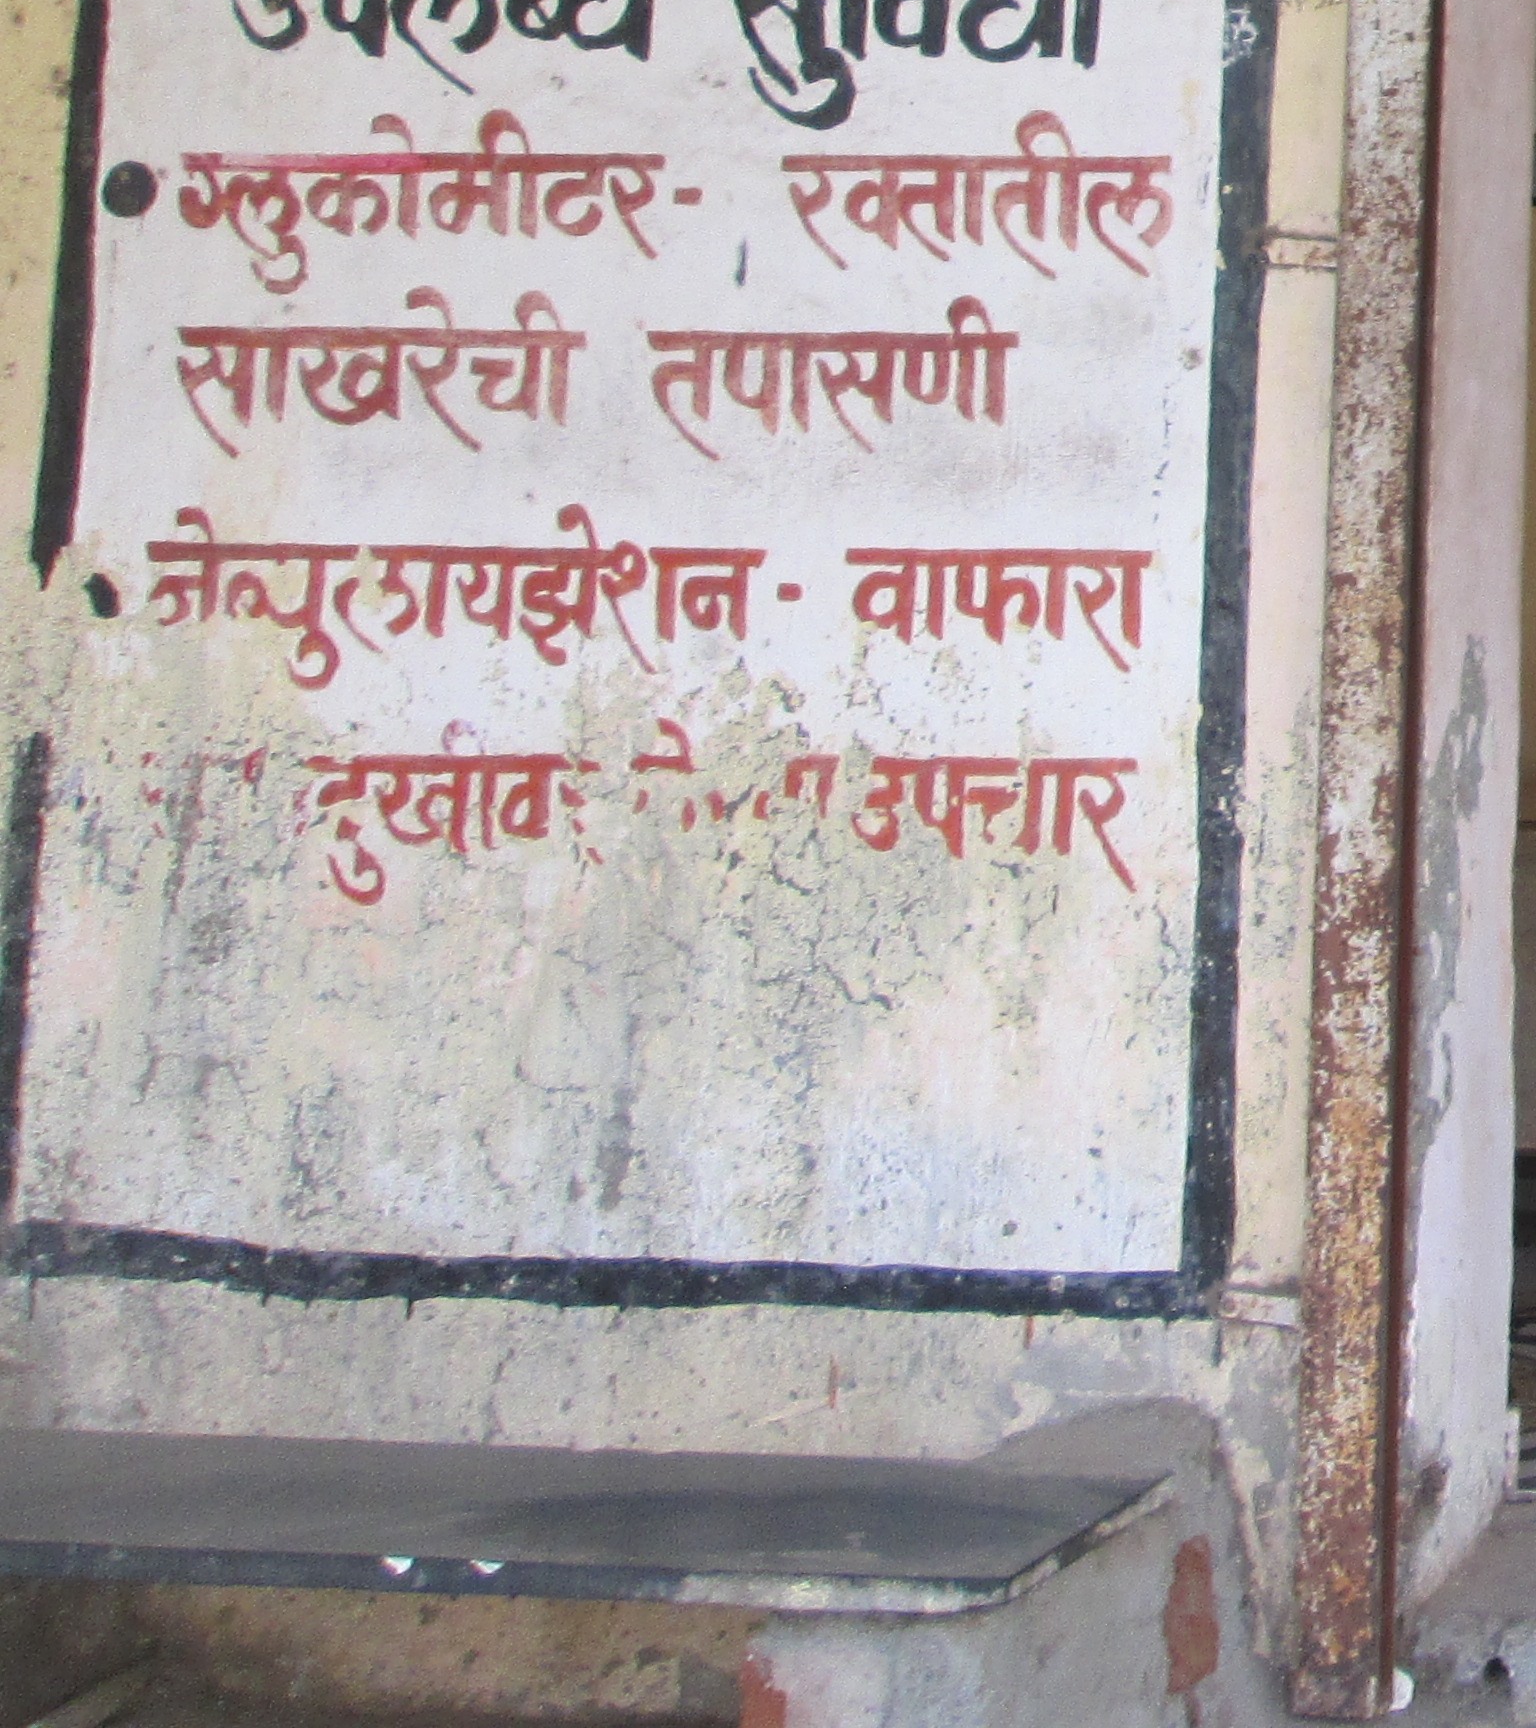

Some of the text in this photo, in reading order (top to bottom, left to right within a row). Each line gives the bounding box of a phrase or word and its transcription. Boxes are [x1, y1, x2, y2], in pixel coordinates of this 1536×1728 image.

[782, 109, 1174, 278] रक्तातील
[176, 284, 1019, 461] साखरेची तपासणी
[847, 546, 1154, 672] वाफारा
